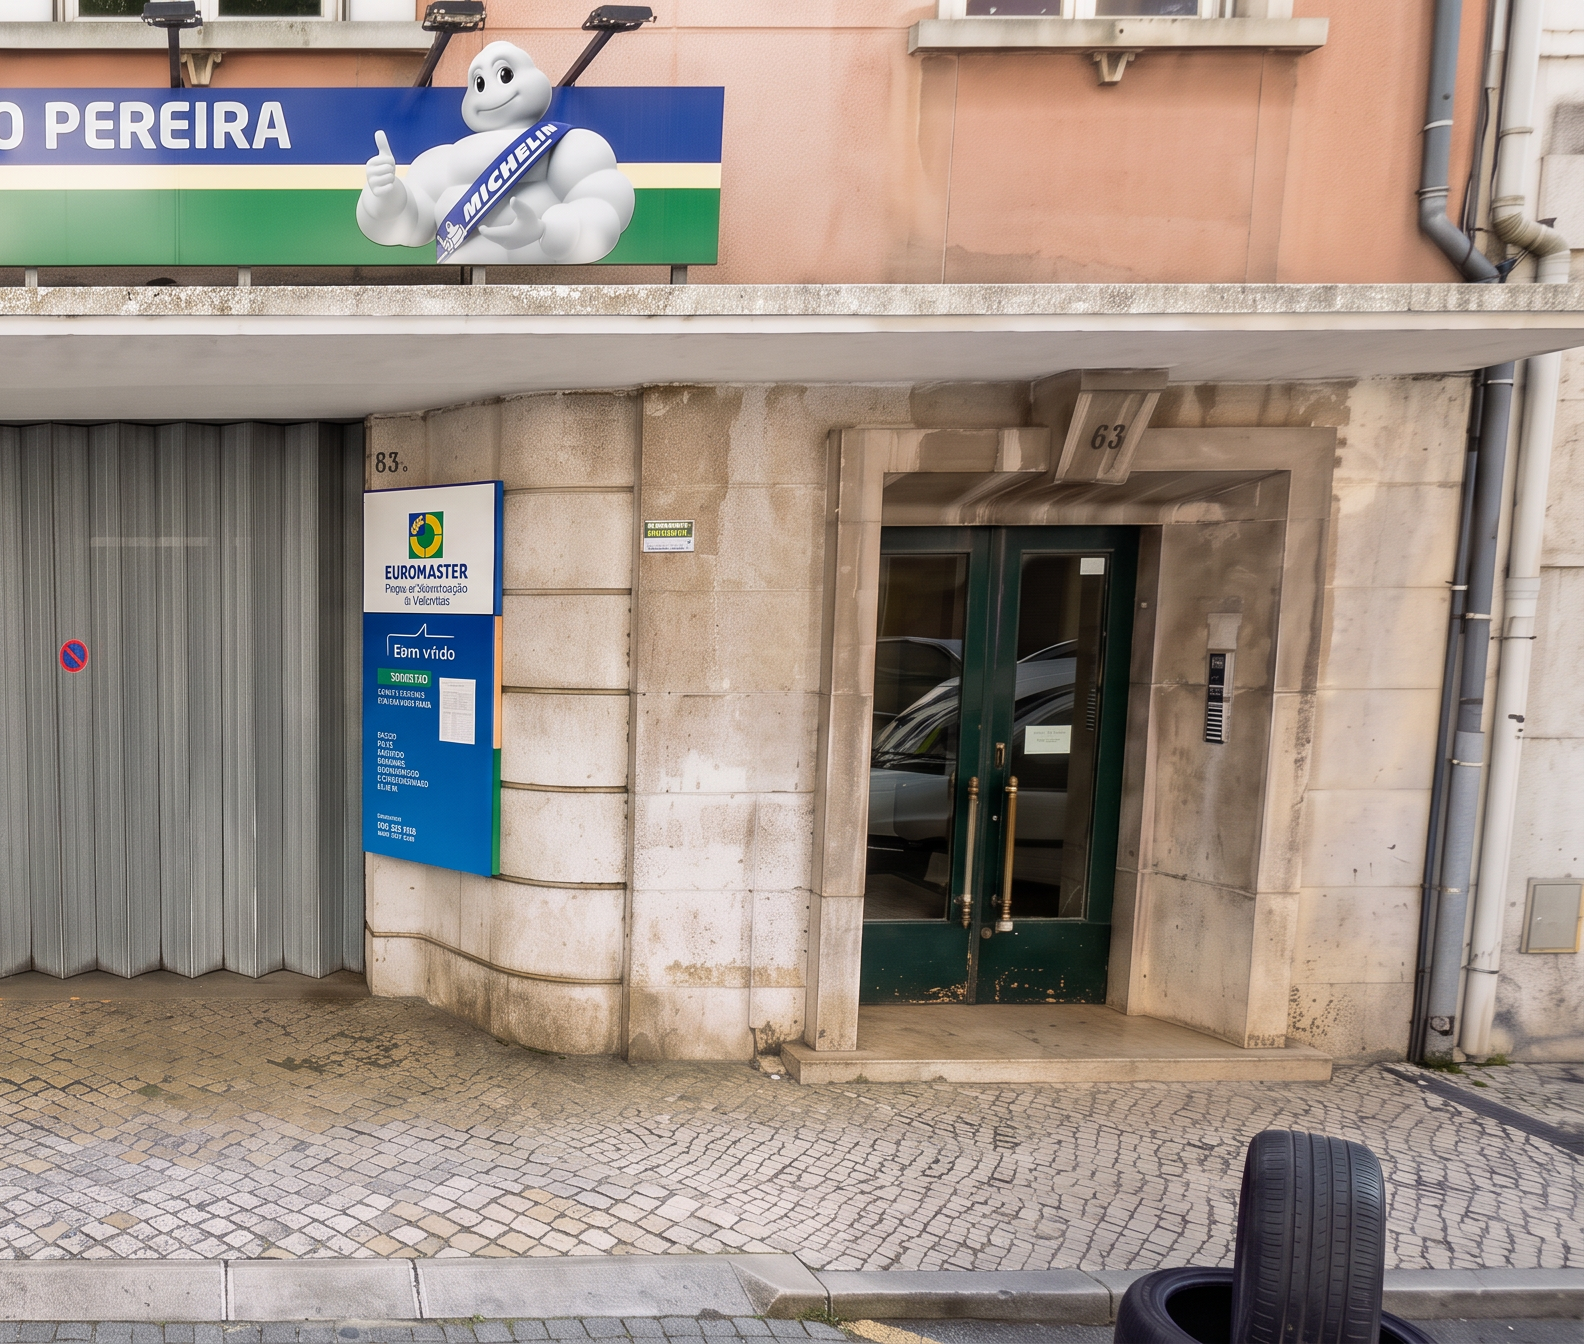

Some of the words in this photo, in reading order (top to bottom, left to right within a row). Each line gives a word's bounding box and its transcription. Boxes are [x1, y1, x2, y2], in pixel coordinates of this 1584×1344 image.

[45, 101, 292, 151] PEREIRA
[462, 123, 558, 223] MICHELIN
[1090, 424, 1126, 450] 63
[384, 563, 469, 580] EUROMASTER
